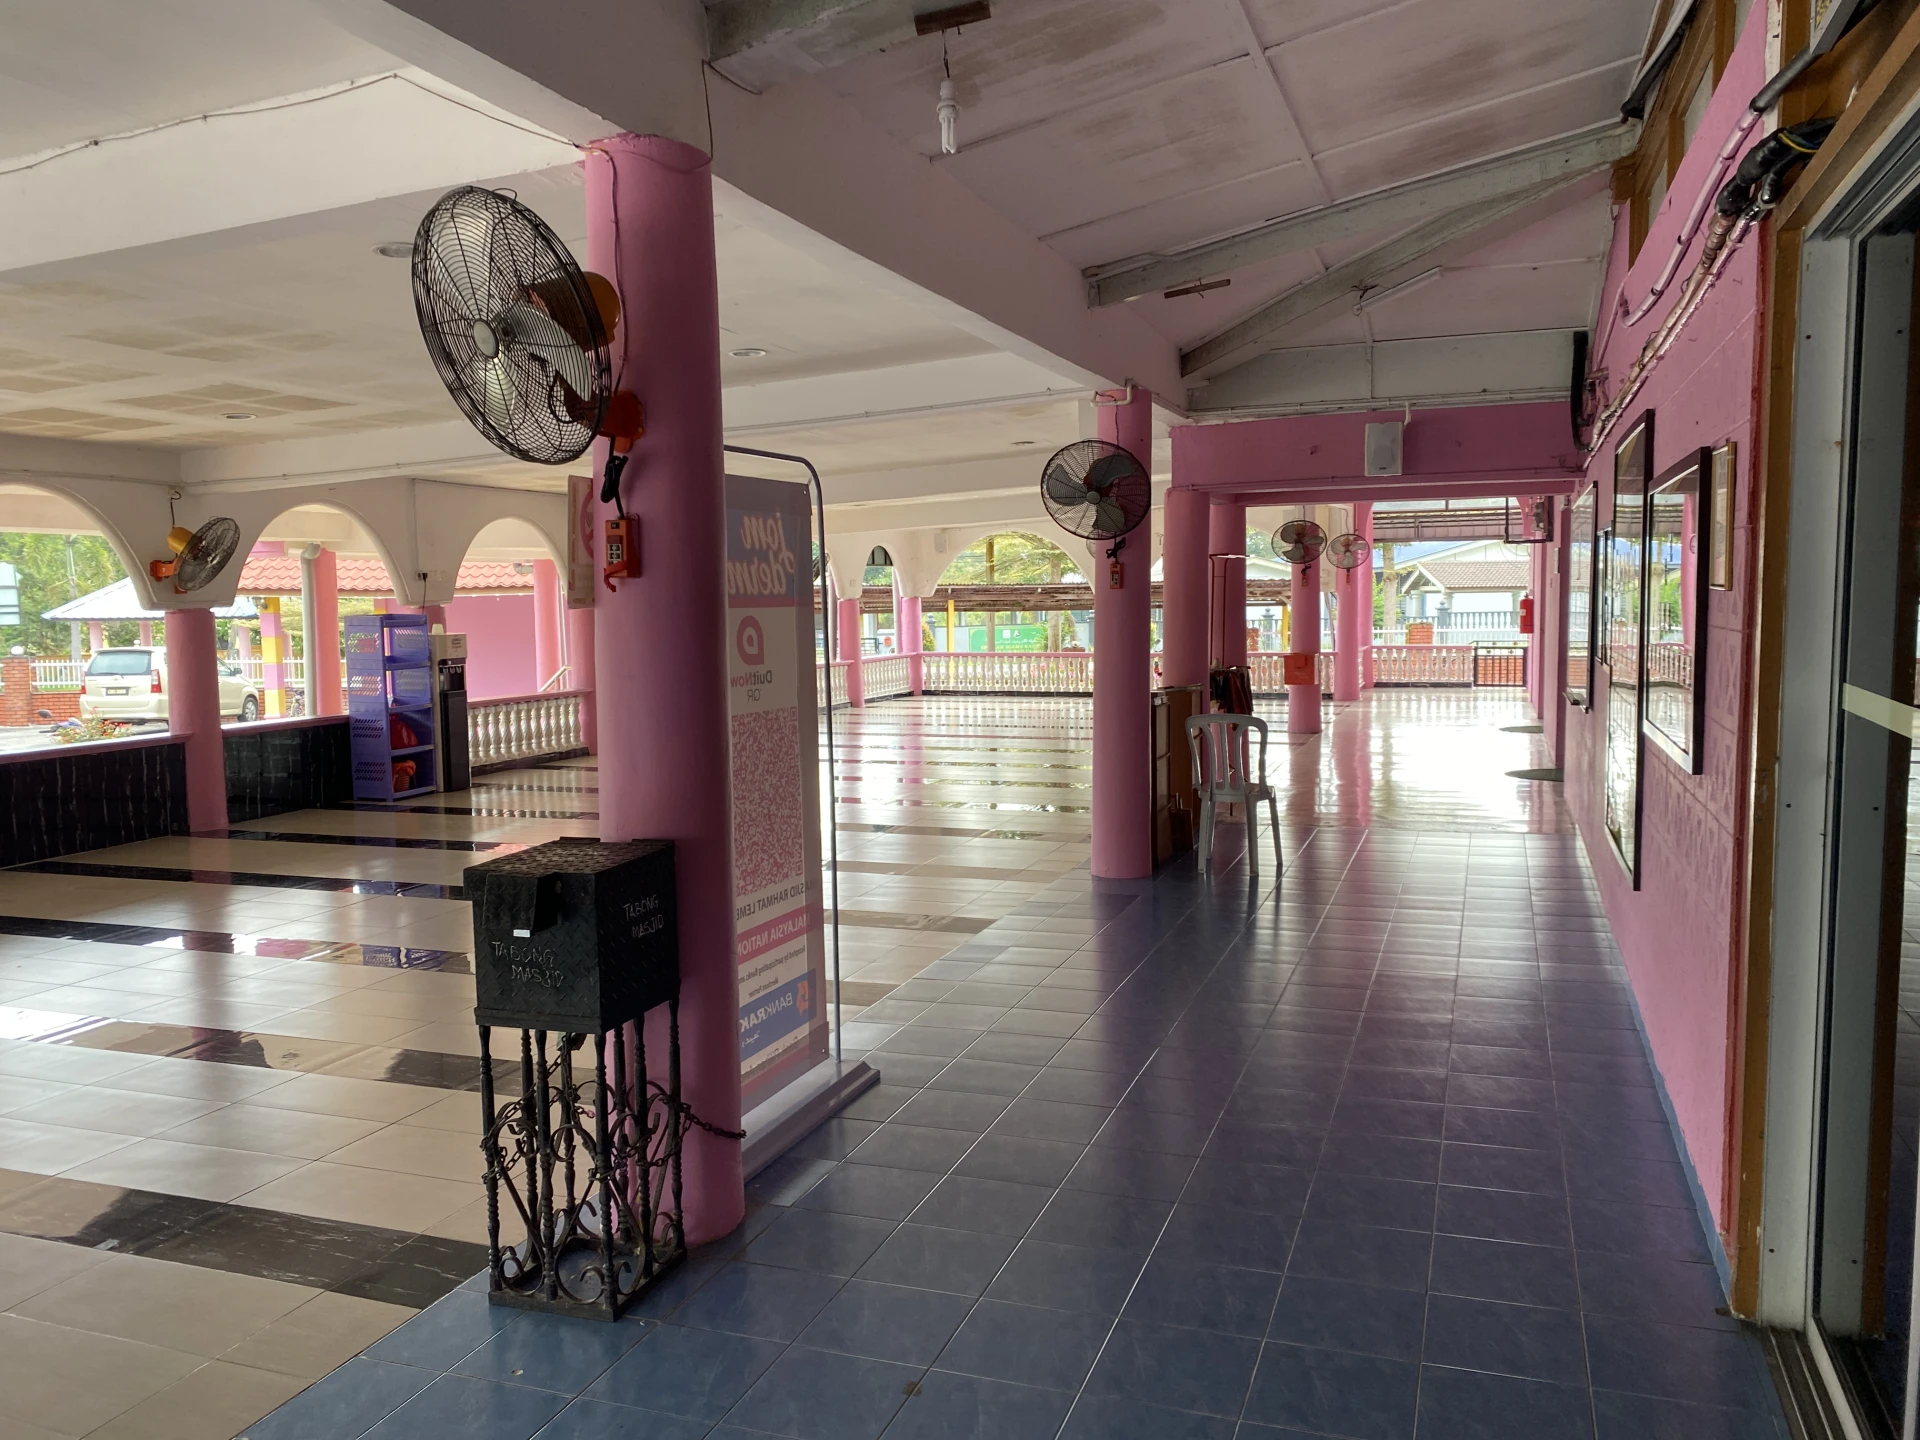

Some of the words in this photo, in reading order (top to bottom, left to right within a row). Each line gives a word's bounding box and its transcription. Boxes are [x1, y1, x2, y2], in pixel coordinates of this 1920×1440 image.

[622, 894, 659, 922] TABONG
[631, 914, 664, 939] MASJID
[491, 941, 555, 968] TABONG
[511, 964, 564, 988] MASJID
